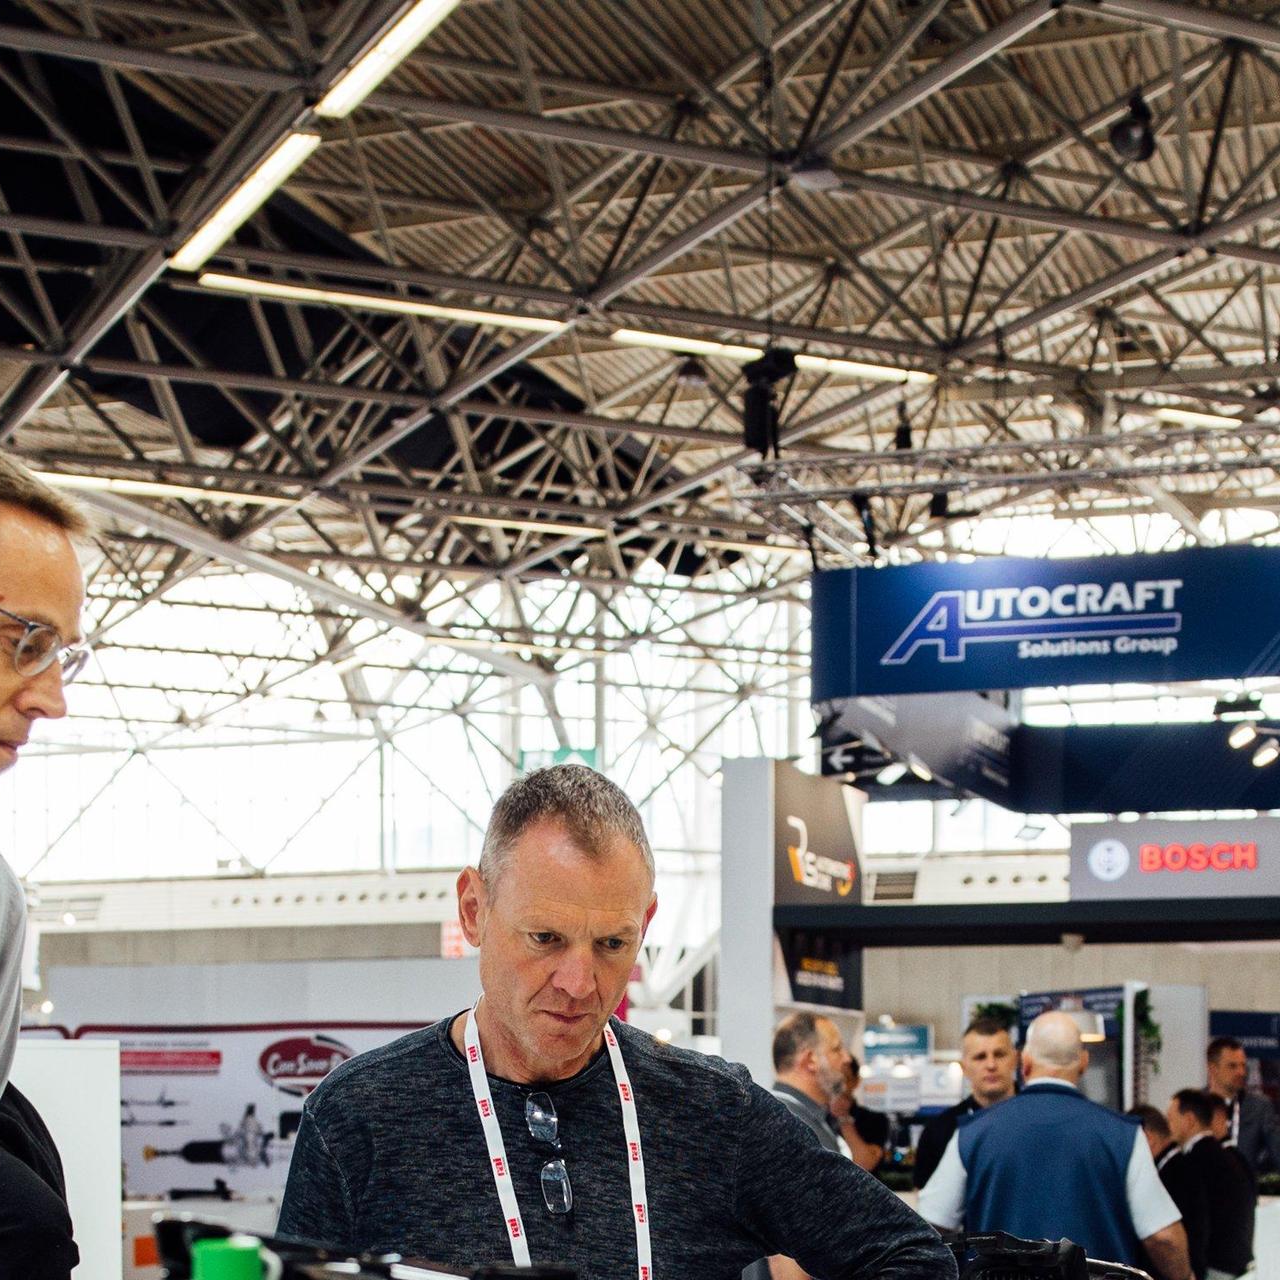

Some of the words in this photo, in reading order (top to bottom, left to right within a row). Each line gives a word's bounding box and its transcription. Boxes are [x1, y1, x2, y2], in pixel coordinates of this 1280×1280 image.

[880, 579, 1183, 665] AUTOCRAFT
[1017, 638, 1111, 659] Solutions
[1113, 635, 1179, 656] Group
[1139, 841, 1258, 874] BOSCH
